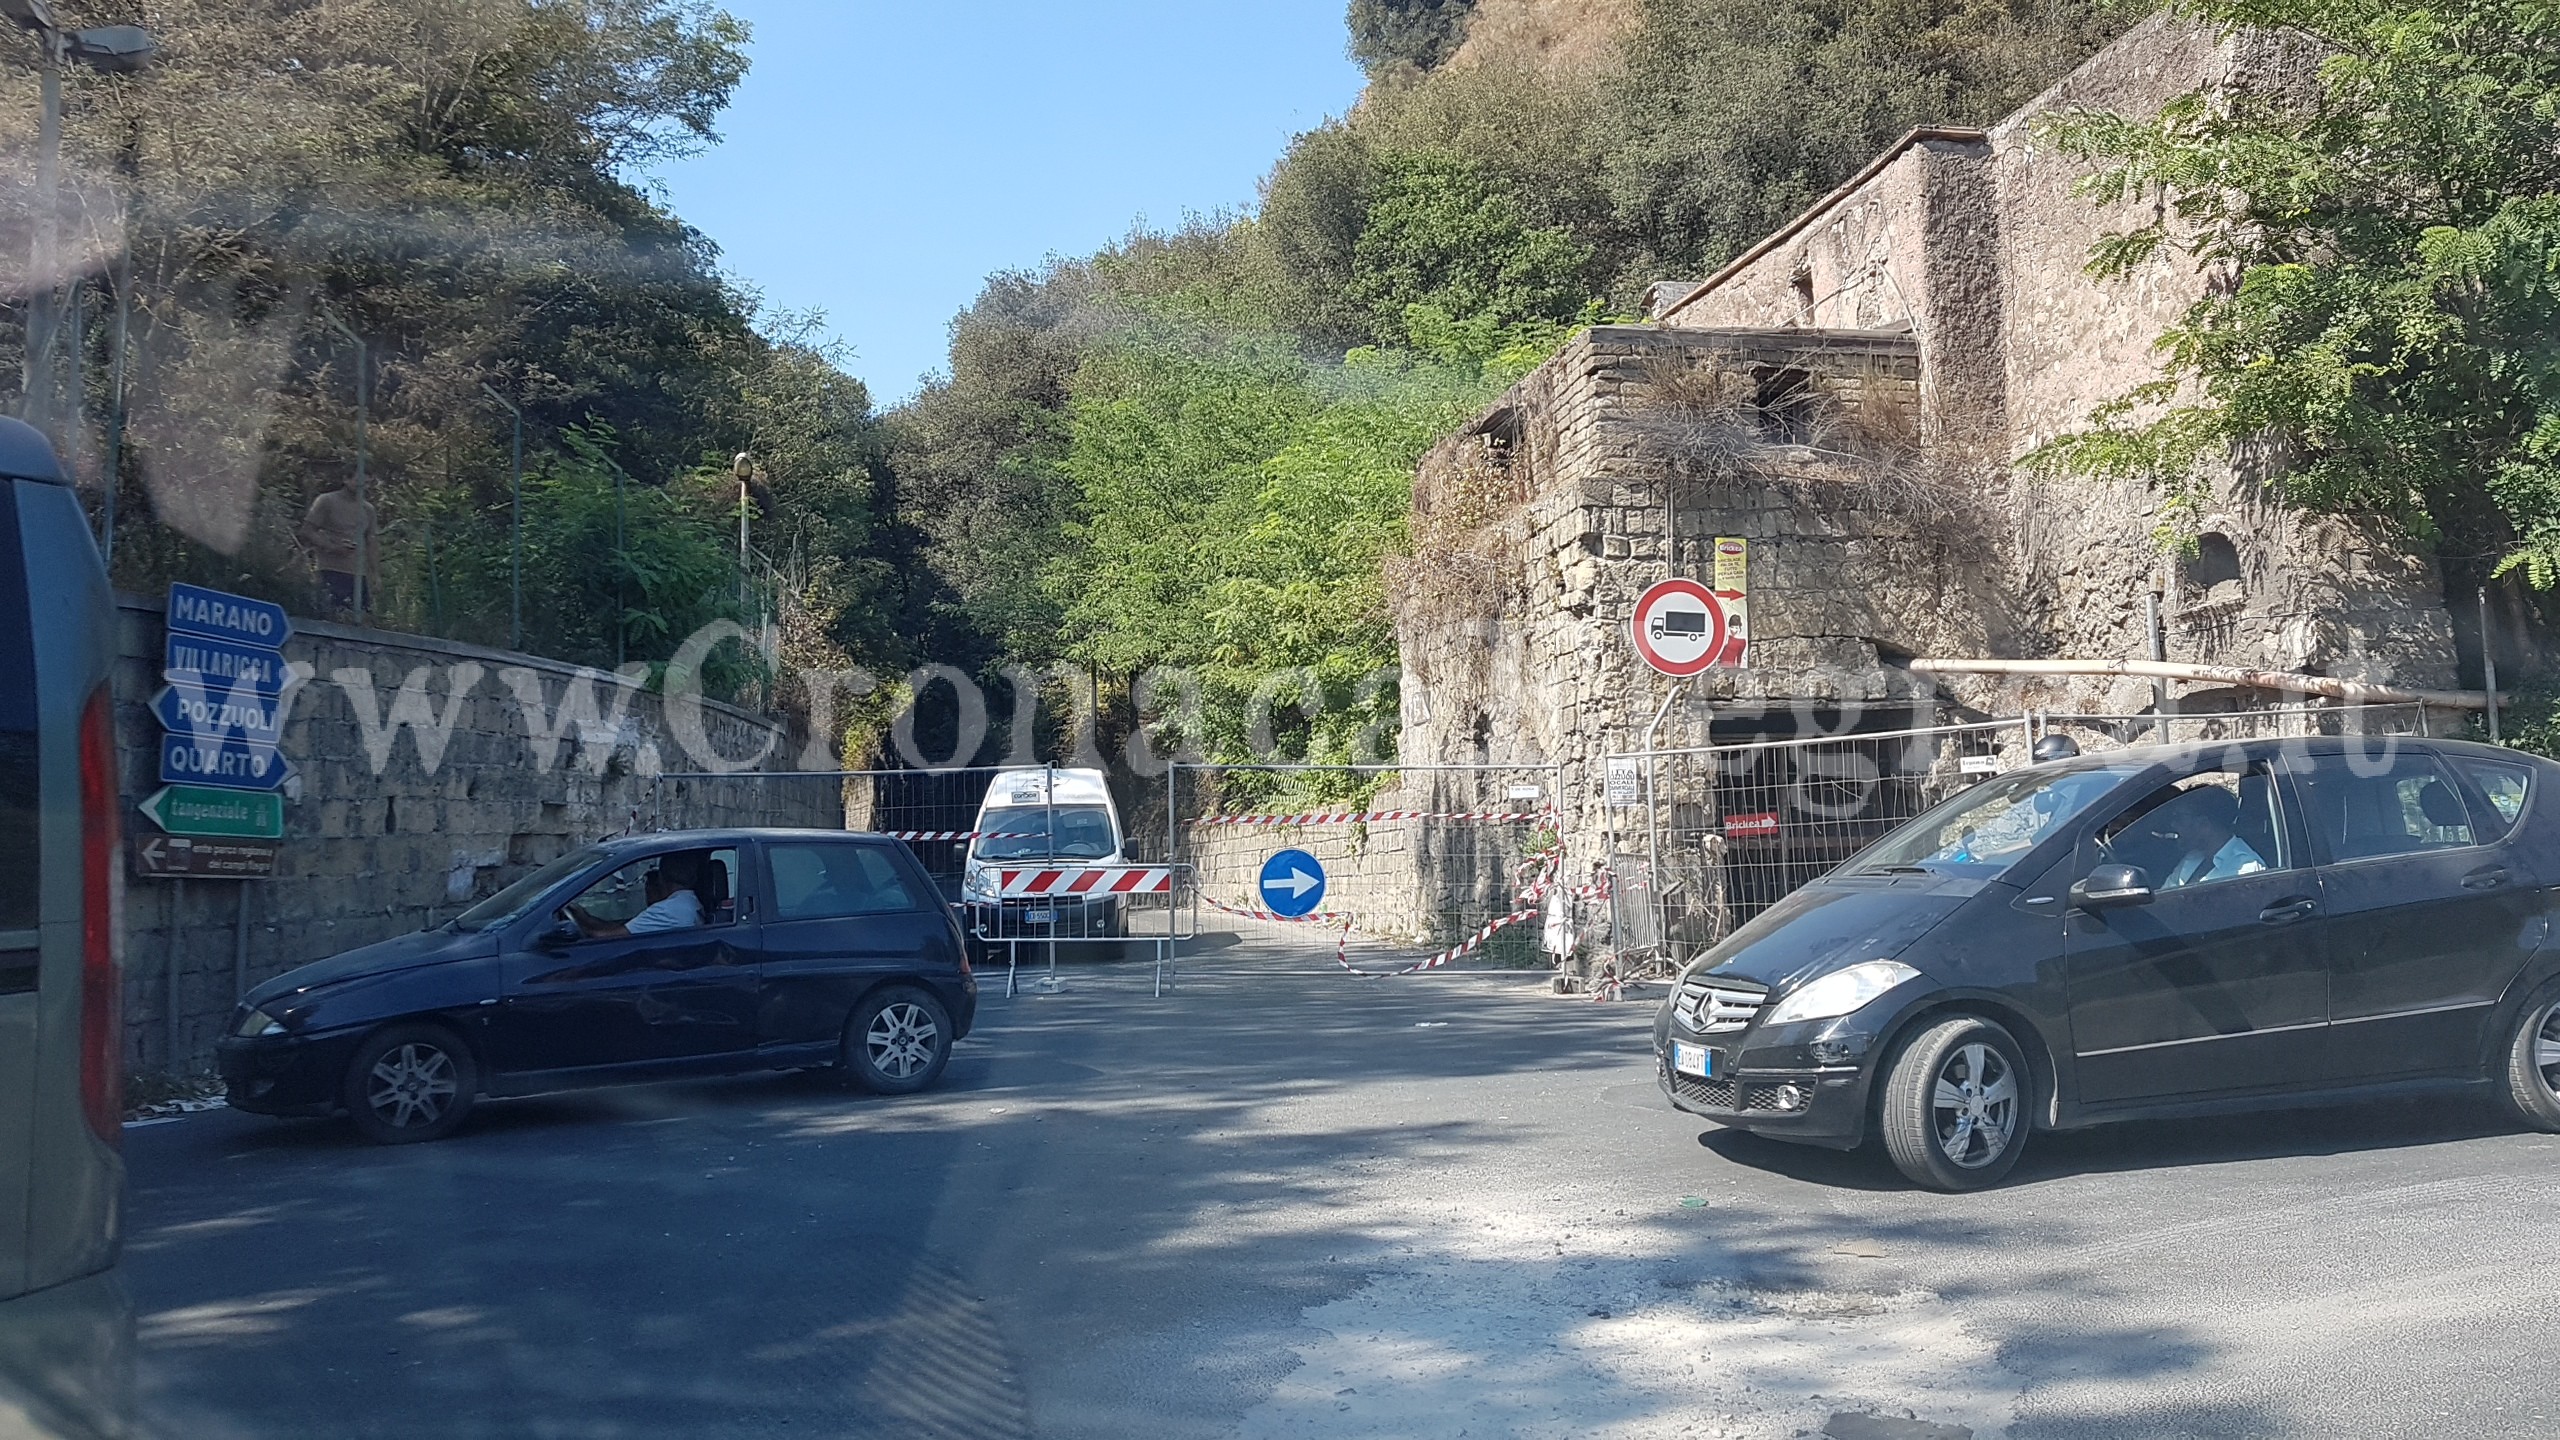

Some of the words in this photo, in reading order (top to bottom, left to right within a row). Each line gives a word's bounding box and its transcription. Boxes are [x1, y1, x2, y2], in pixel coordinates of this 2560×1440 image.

[174, 594, 274, 637] MARANO
[173, 644, 272, 684] VILLARICCA
[176, 697, 276, 732] POZZUOLI
[170, 745, 269, 780] QUARTO
[170, 798, 249, 822] tangenziale
[1725, 820, 1760, 831] Brickea
